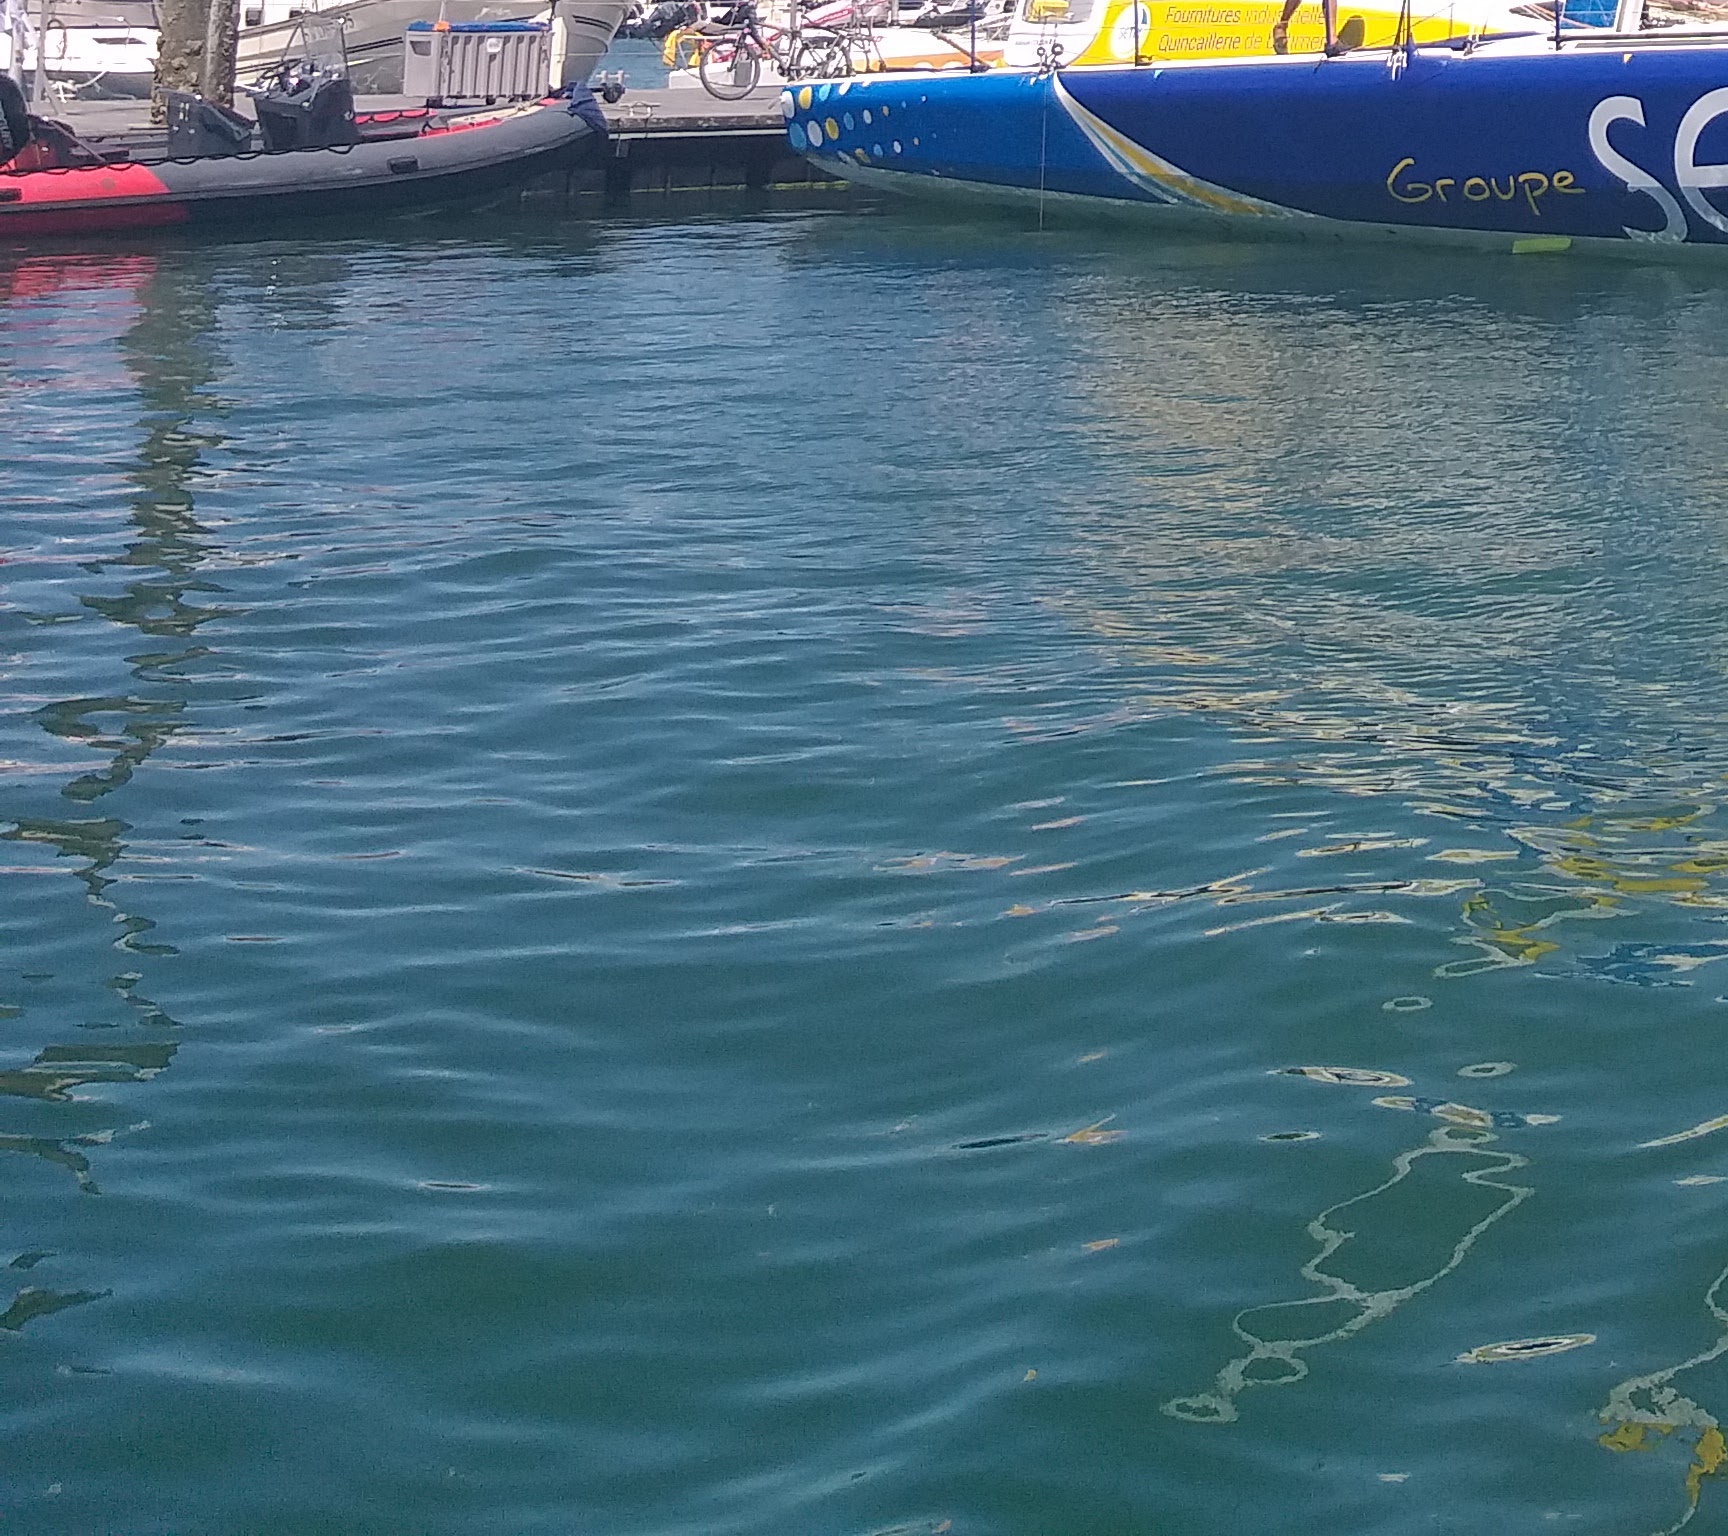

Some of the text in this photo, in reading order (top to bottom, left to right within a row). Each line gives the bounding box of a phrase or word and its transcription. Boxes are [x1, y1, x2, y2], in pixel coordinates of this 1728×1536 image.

[1165, 5, 1241, 25] Fournitures
[1158, 31, 1241, 53] Quincaillerie
[1244, 32, 1263, 50] de
[1387, 157, 1587, 216] Groupe
